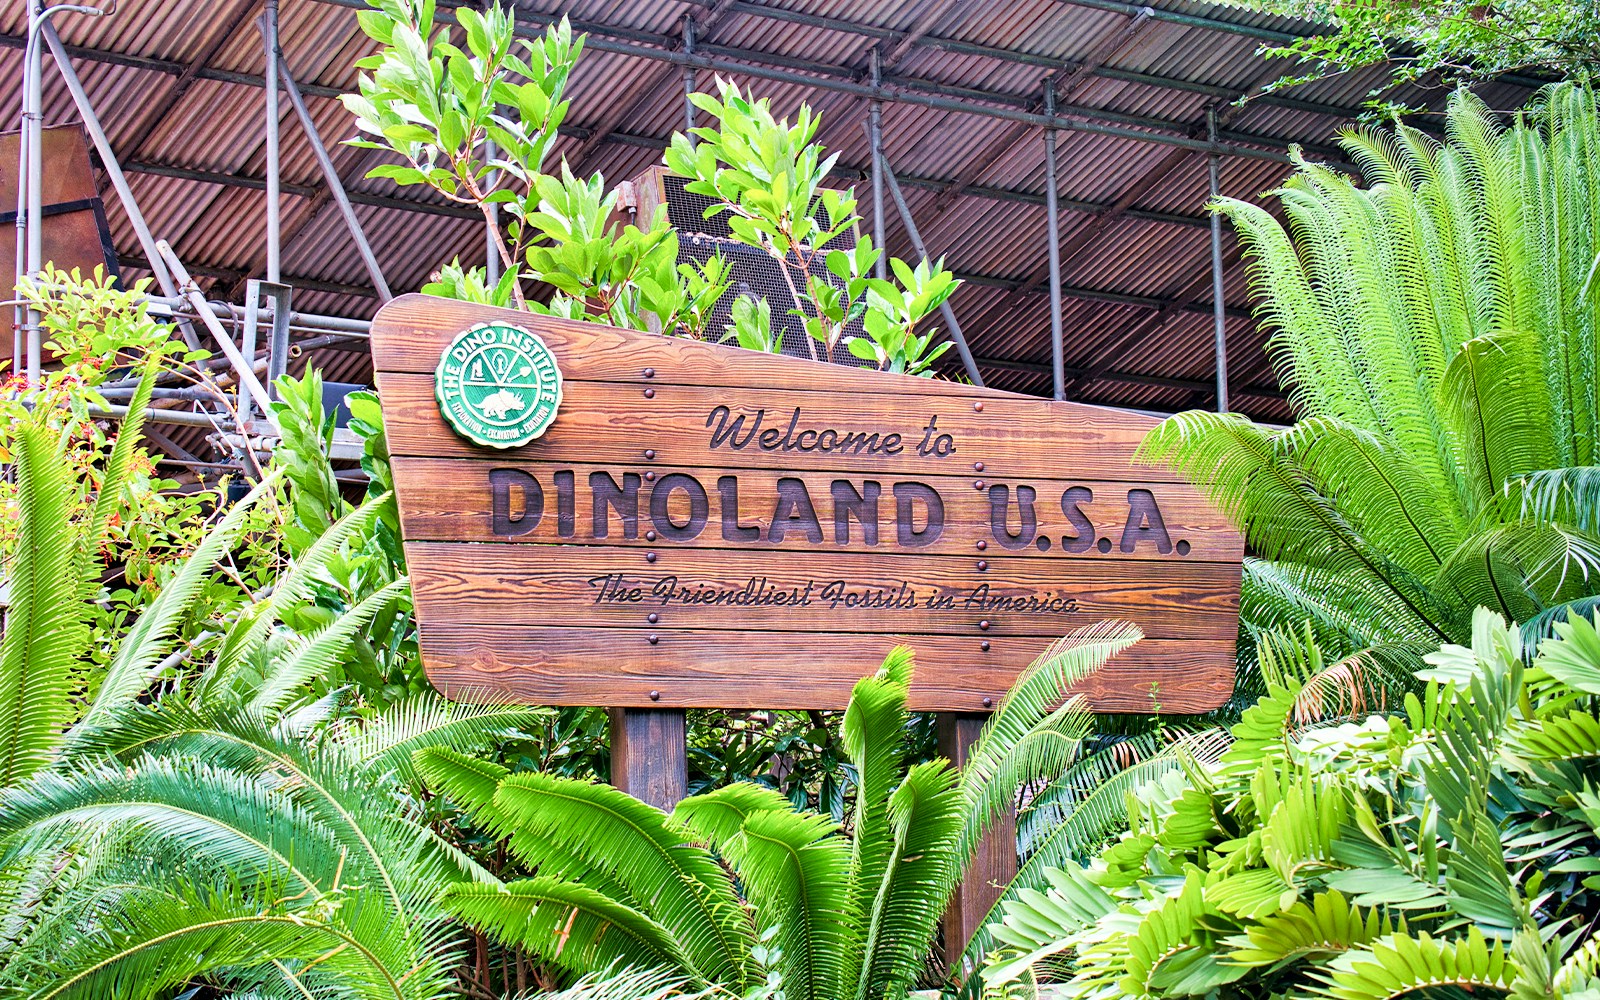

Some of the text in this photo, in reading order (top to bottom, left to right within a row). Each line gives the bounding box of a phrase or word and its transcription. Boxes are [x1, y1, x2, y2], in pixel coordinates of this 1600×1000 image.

[443, 329, 557, 404] THE DINO INSTITUTE
[451, 401, 483, 434] EXPLORATION
[487, 428, 521, 440] EXCAVATION
[705, 404, 957, 458] Welcome to
[488, 467, 1192, 555] DINOLAND U.S.A.
[587, 573, 1080, 614] The Friendliest Fossils in America
